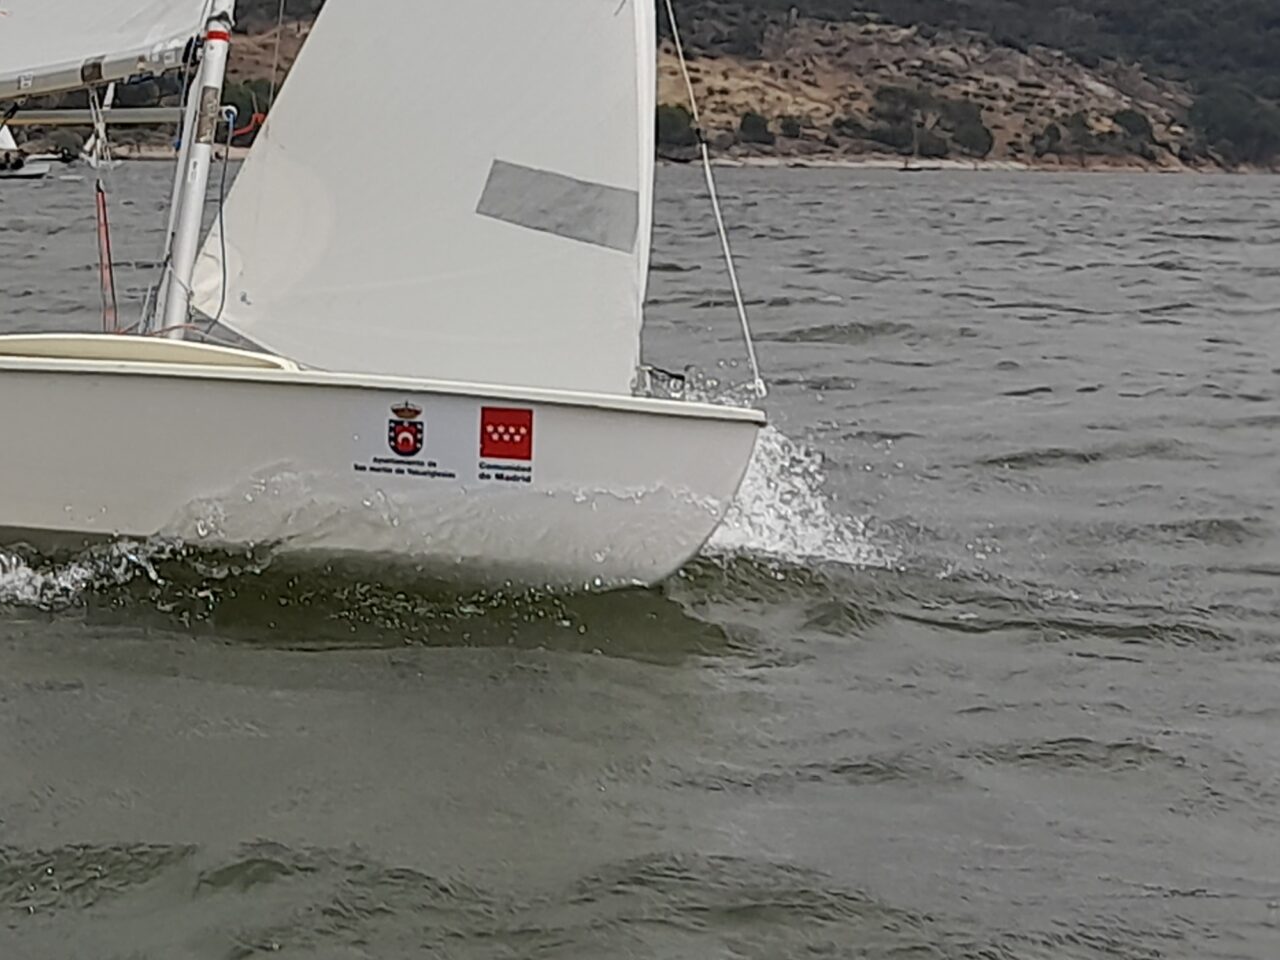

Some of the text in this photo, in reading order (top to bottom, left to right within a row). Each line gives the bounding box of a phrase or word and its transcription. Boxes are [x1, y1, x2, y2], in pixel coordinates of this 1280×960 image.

[478, 461, 532, 473] Comunidad
[478, 472, 532, 483] de Madrid
